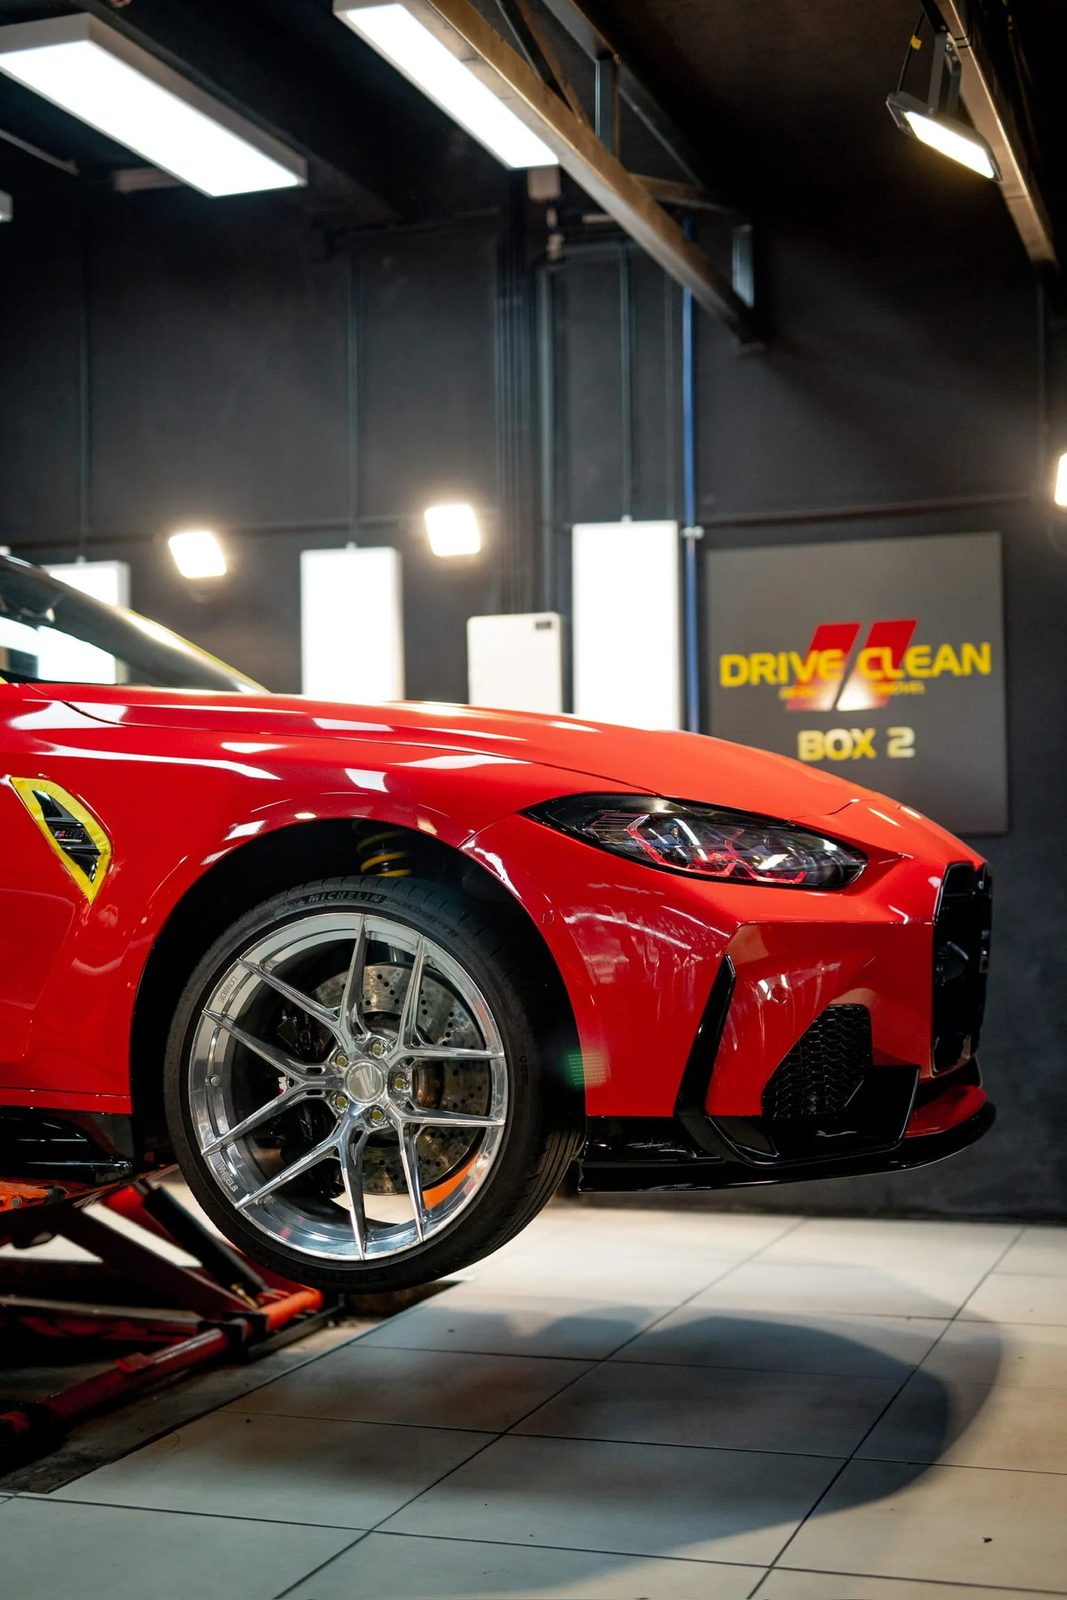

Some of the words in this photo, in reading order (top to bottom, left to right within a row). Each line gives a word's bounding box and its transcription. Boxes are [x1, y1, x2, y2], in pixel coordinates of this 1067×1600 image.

[719, 649, 844, 687] DRIVE
[856, 642, 992, 680] CLEAN
[797, 728, 877, 761] BOX
[886, 726, 916, 758] 2
[308, 891, 382, 903] MICHELIN
